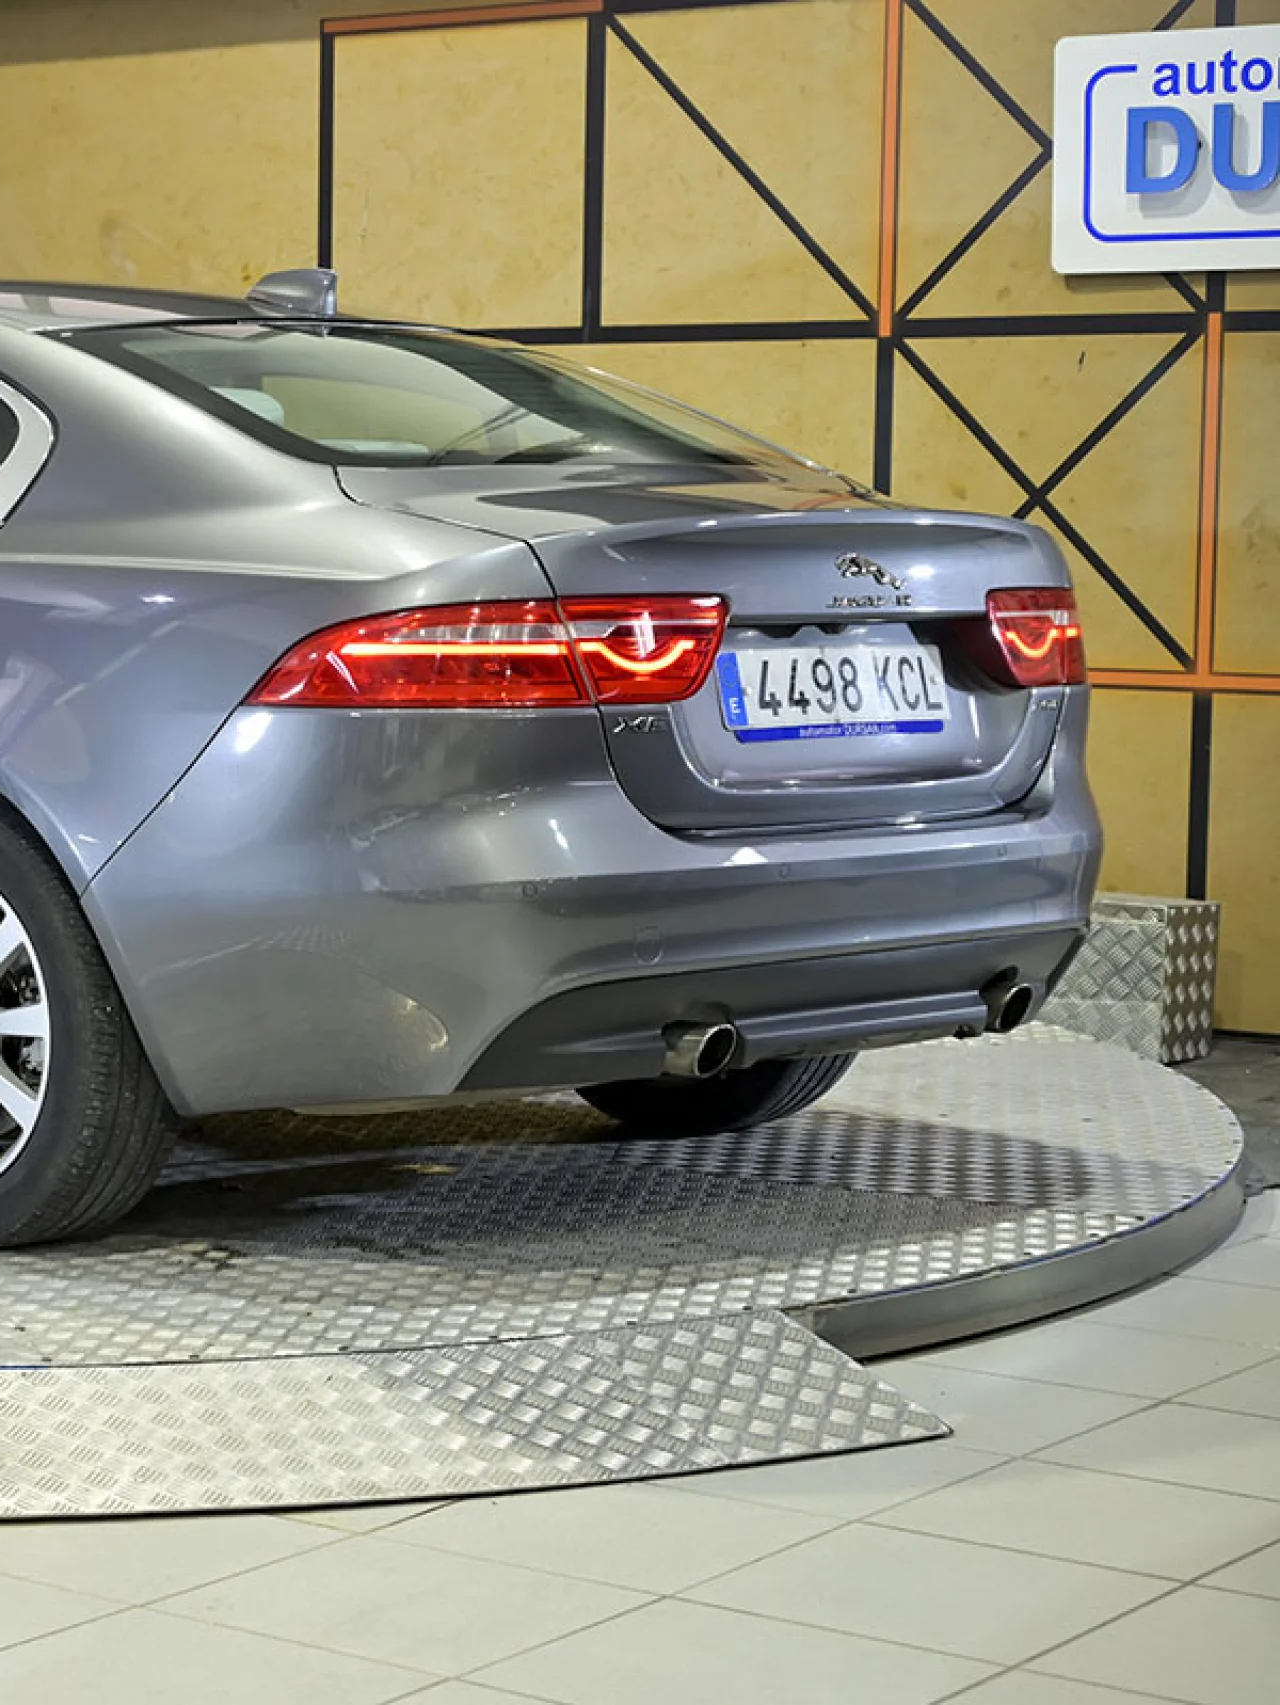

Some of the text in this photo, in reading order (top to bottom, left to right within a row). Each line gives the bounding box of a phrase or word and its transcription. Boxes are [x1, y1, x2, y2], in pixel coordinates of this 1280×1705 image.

[1151, 49, 1280, 97] auto
[729, 697, 741, 714] E
[758, 655, 944, 717] 4498 KCL
